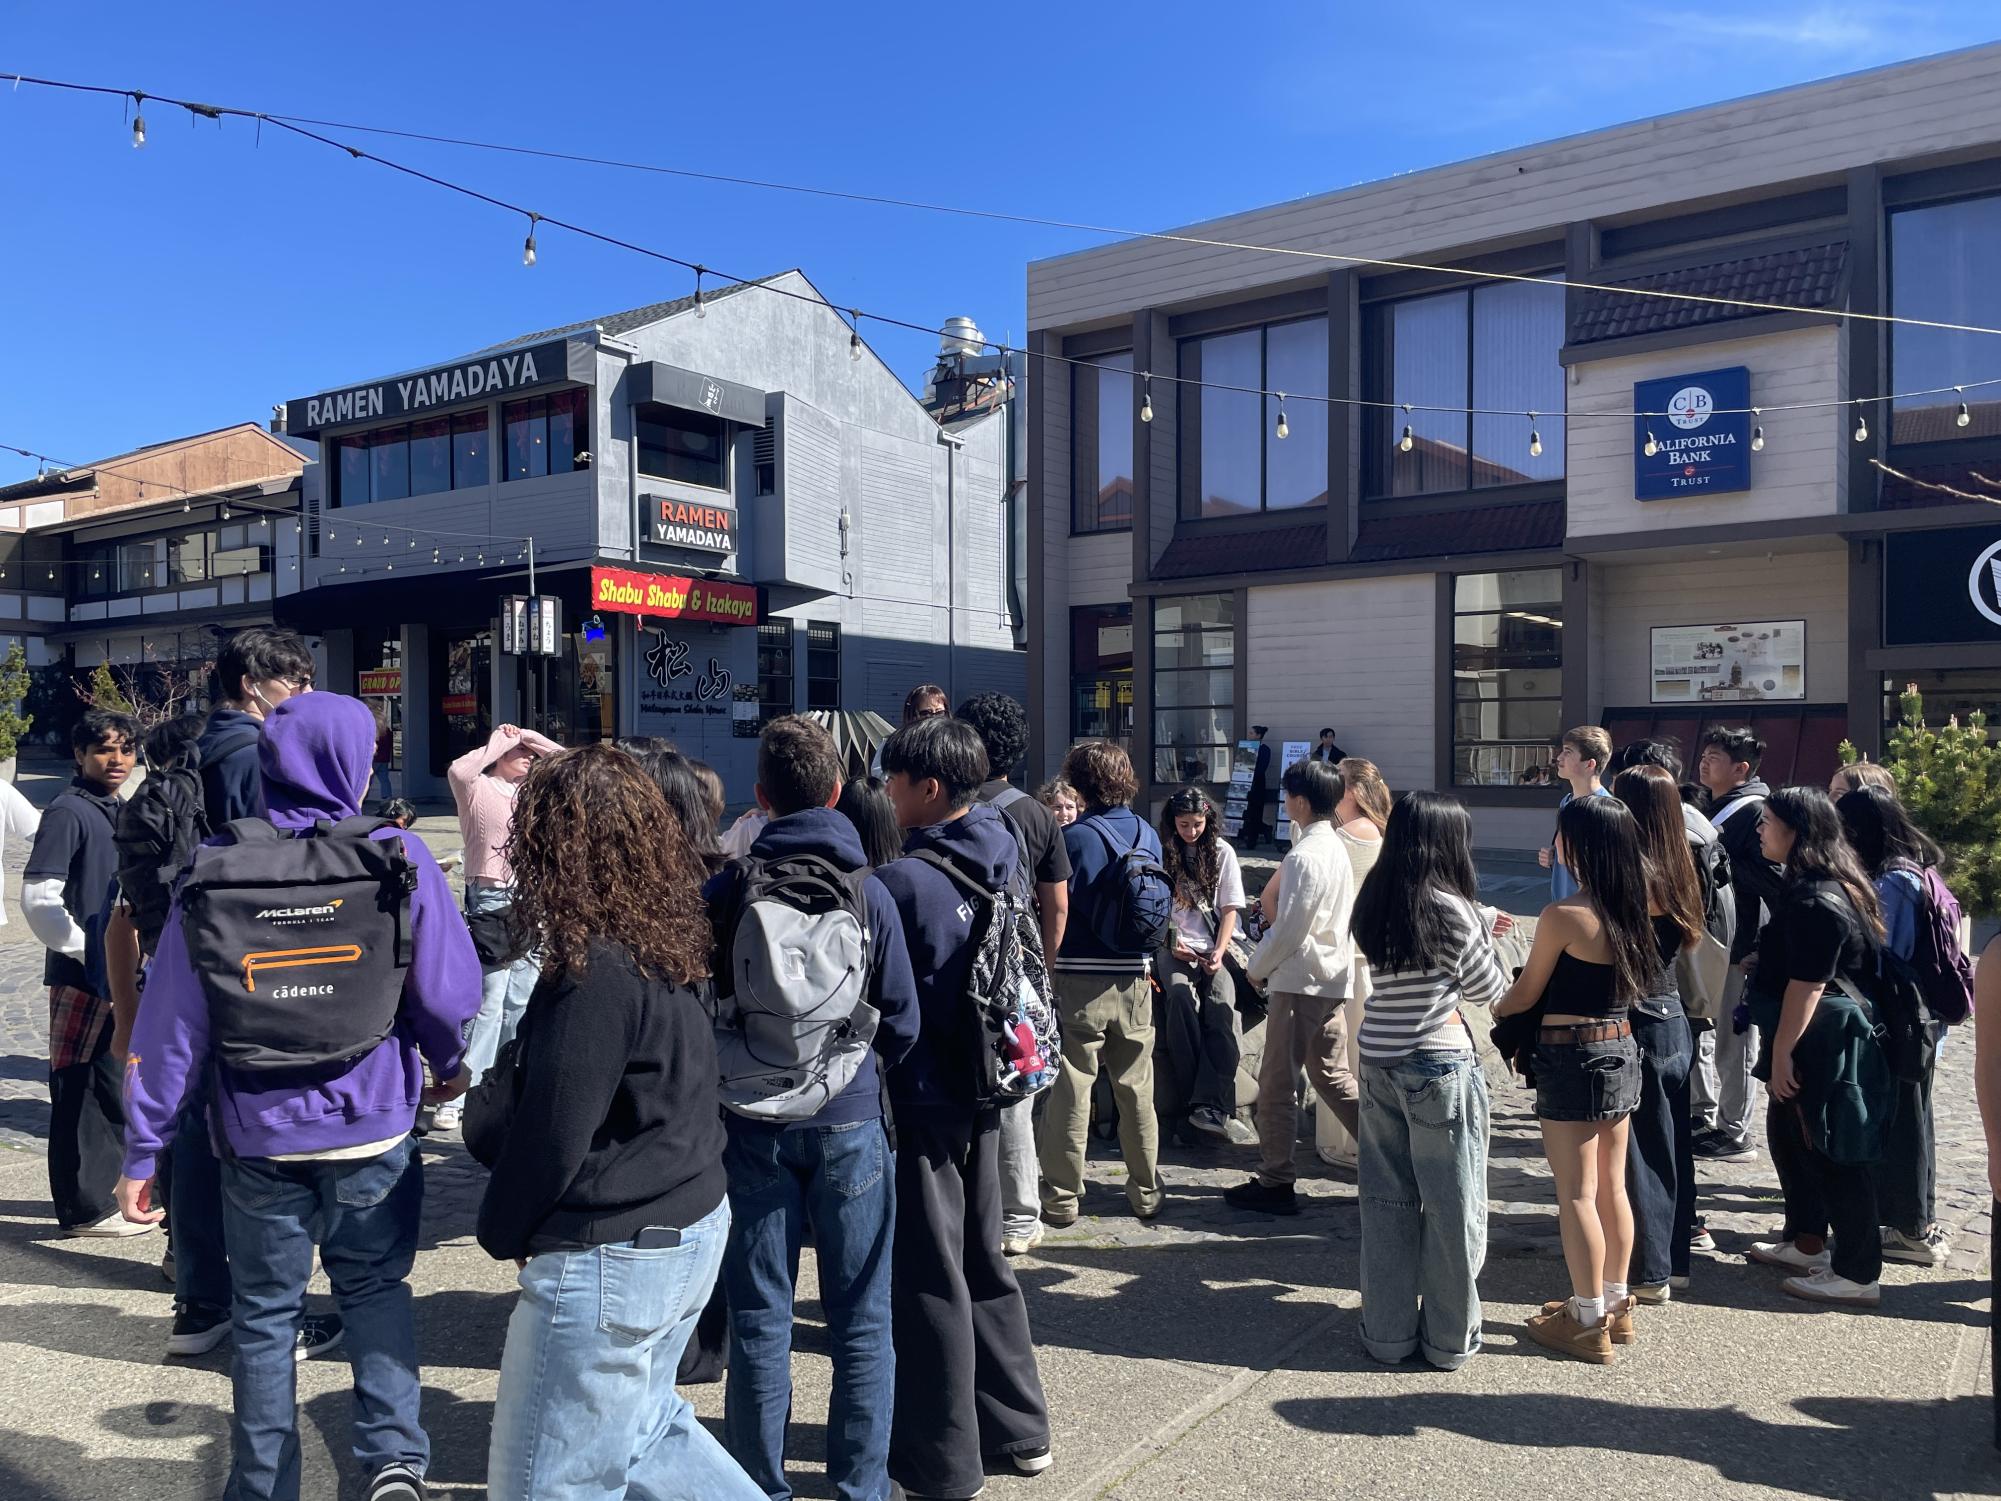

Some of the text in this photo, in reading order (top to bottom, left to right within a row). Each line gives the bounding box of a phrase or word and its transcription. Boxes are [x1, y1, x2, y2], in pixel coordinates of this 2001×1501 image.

[307, 352, 539, 427] RAMEN YAMADAYA
[1673, 394, 1707, 411] C B
[1676, 417, 1704, 425] TRUST
[1668, 450, 1712, 465] BANK
[1672, 476, 1710, 486] TRUST
[660, 500, 729, 530] RAMEN
[657, 523, 732, 550] YAMADAYA
[599, 579, 753, 619] Shabu Shabu & Izakaya
[362, 676, 387, 690] GRAND
[255, 905, 334, 919] McLaren
[272, 984, 334, 999] cādence
